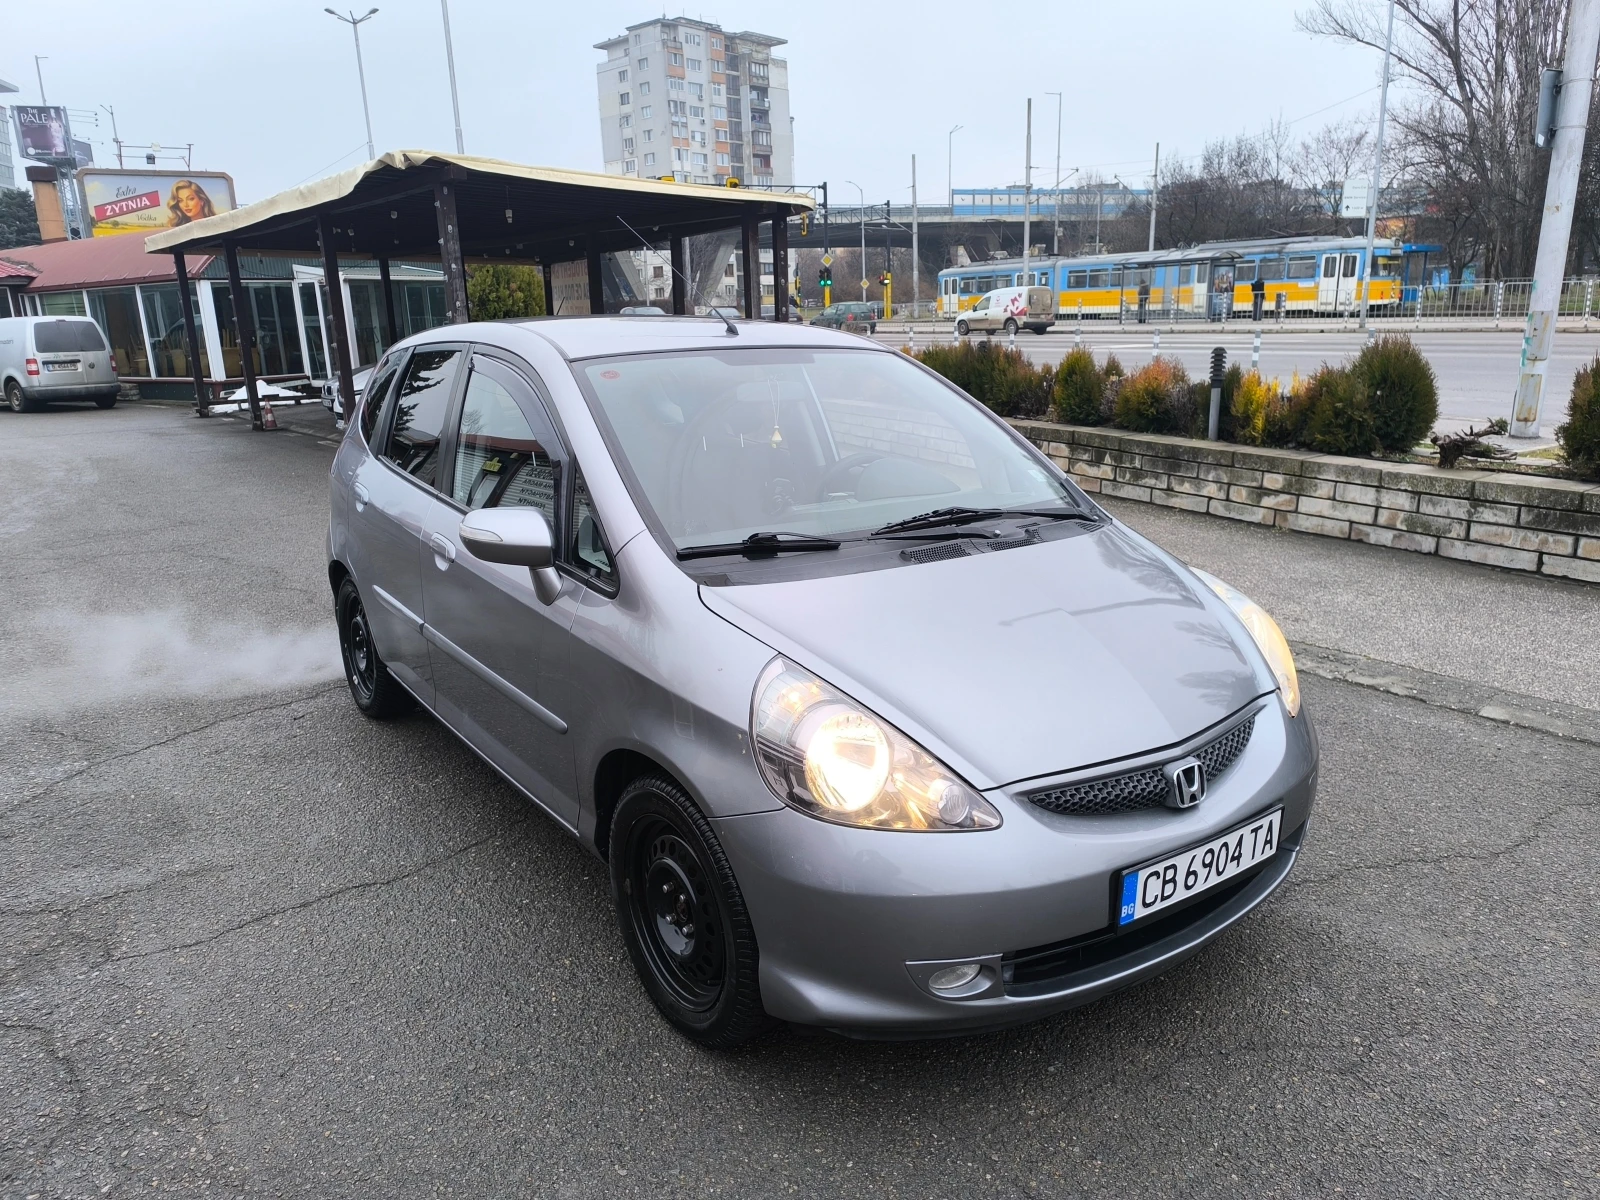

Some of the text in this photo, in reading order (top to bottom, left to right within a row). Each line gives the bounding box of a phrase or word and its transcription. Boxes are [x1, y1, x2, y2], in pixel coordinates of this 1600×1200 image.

[20, 113, 48, 124] PALE
[115, 185, 137, 198] Extra
[104, 196, 151, 216] ŻYTNIA
[1141, 818, 1274, 909] CB 6904 TA
[1121, 902, 1135, 918] BG
